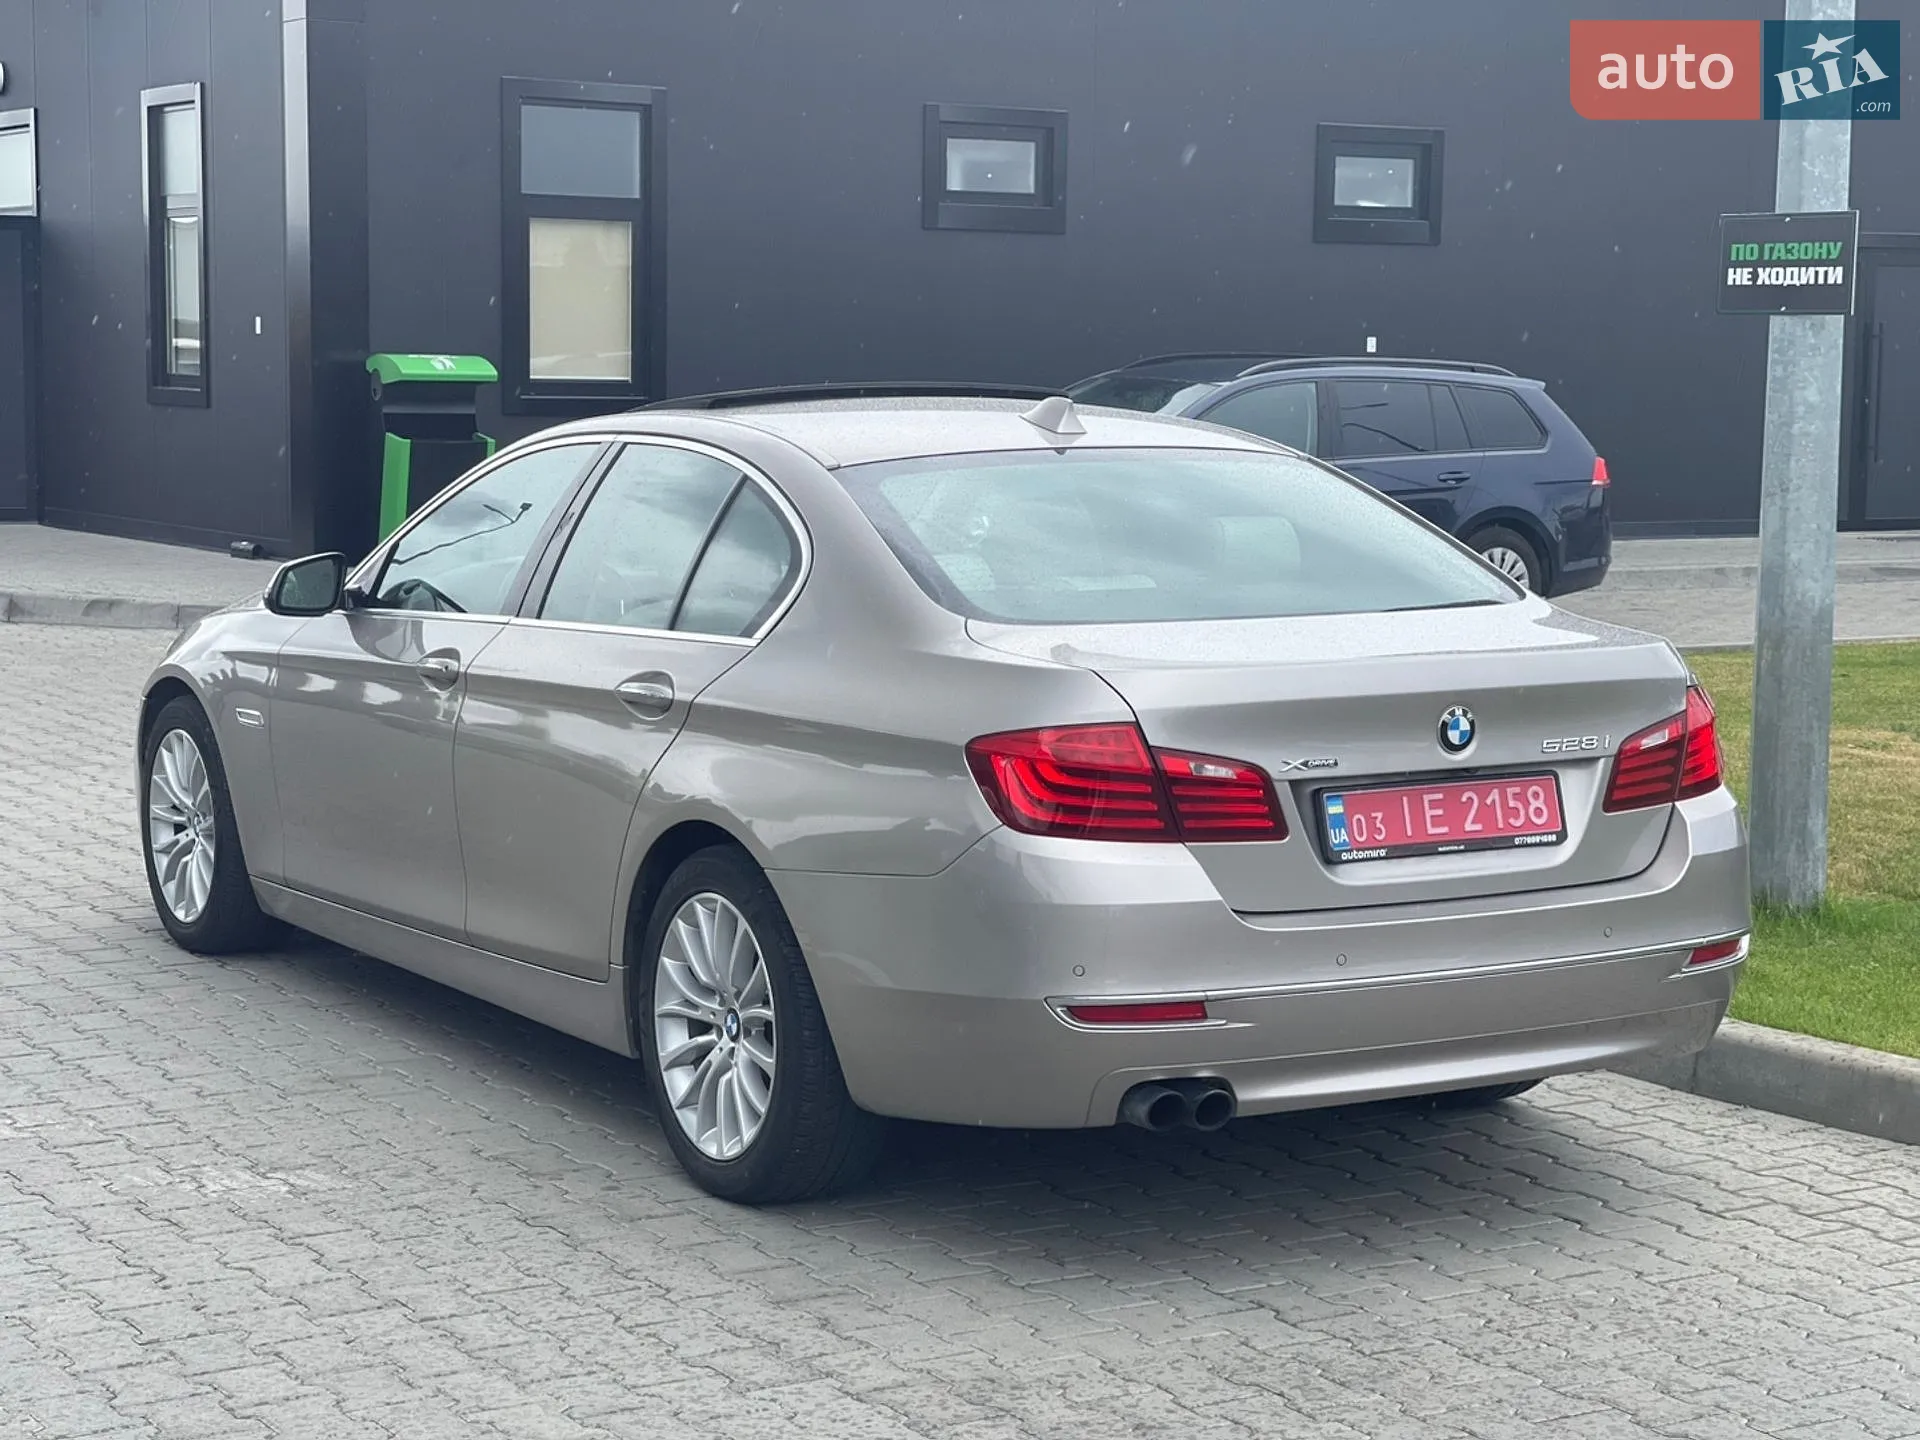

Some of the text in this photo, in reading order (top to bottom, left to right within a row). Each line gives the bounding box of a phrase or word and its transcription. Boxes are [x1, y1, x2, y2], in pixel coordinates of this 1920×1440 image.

[1730, 241, 1843, 261] ПО ГАЗОНУ
[1727, 266, 1844, 287] НЕ ХОДИТИ
[1351, 785, 1549, 843] 03 IE 2158
[1330, 827, 1350, 844] UA
